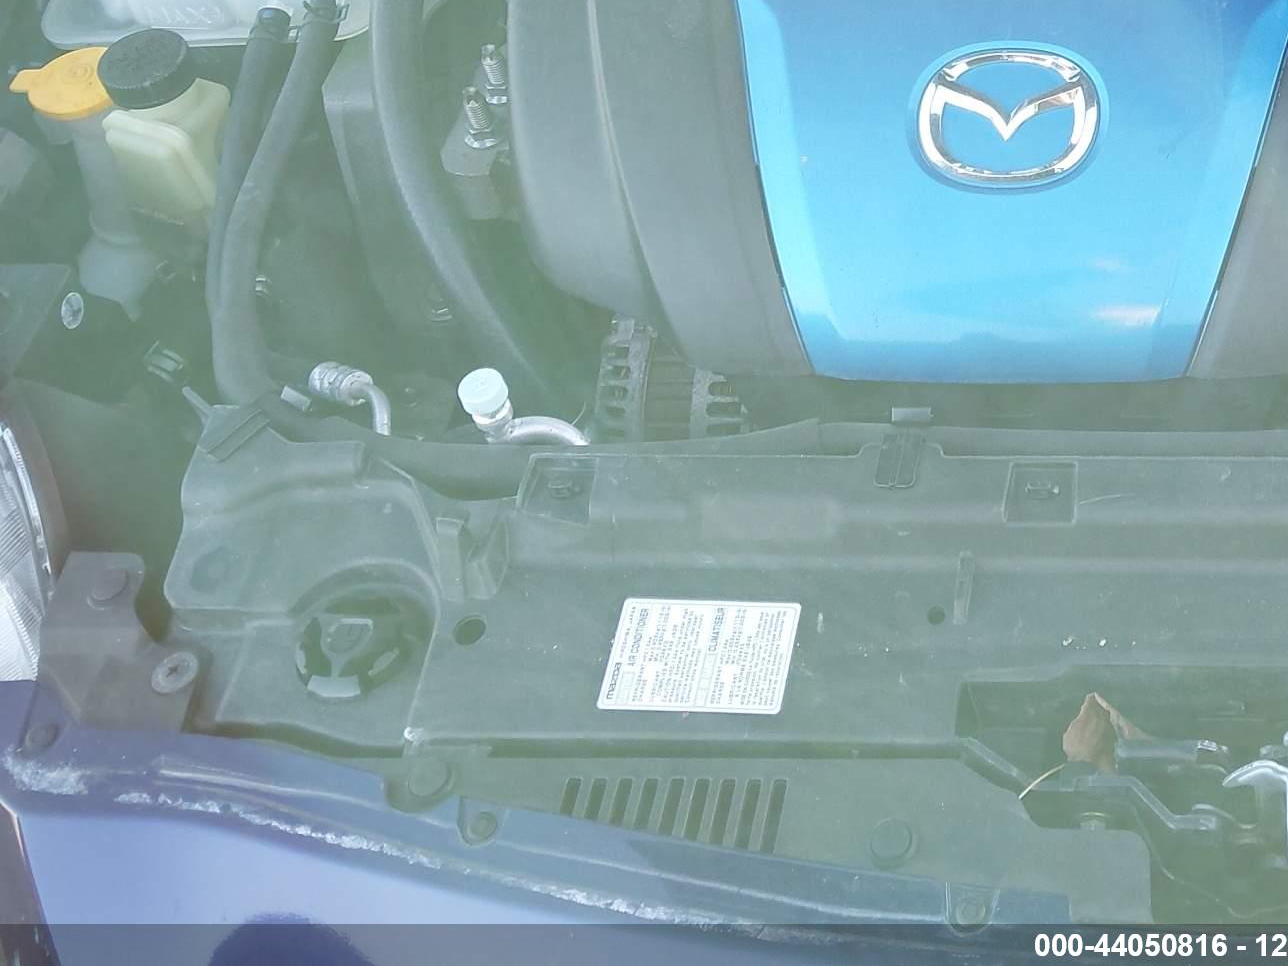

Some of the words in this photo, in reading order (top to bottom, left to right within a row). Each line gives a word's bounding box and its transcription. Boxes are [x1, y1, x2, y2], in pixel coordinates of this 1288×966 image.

[629, 608, 649, 653] CONDITIONER
[707, 607, 725, 651] CLIMATISEUR
[605, 662, 621, 699] mazda
[626, 655, 637, 666] AIR
